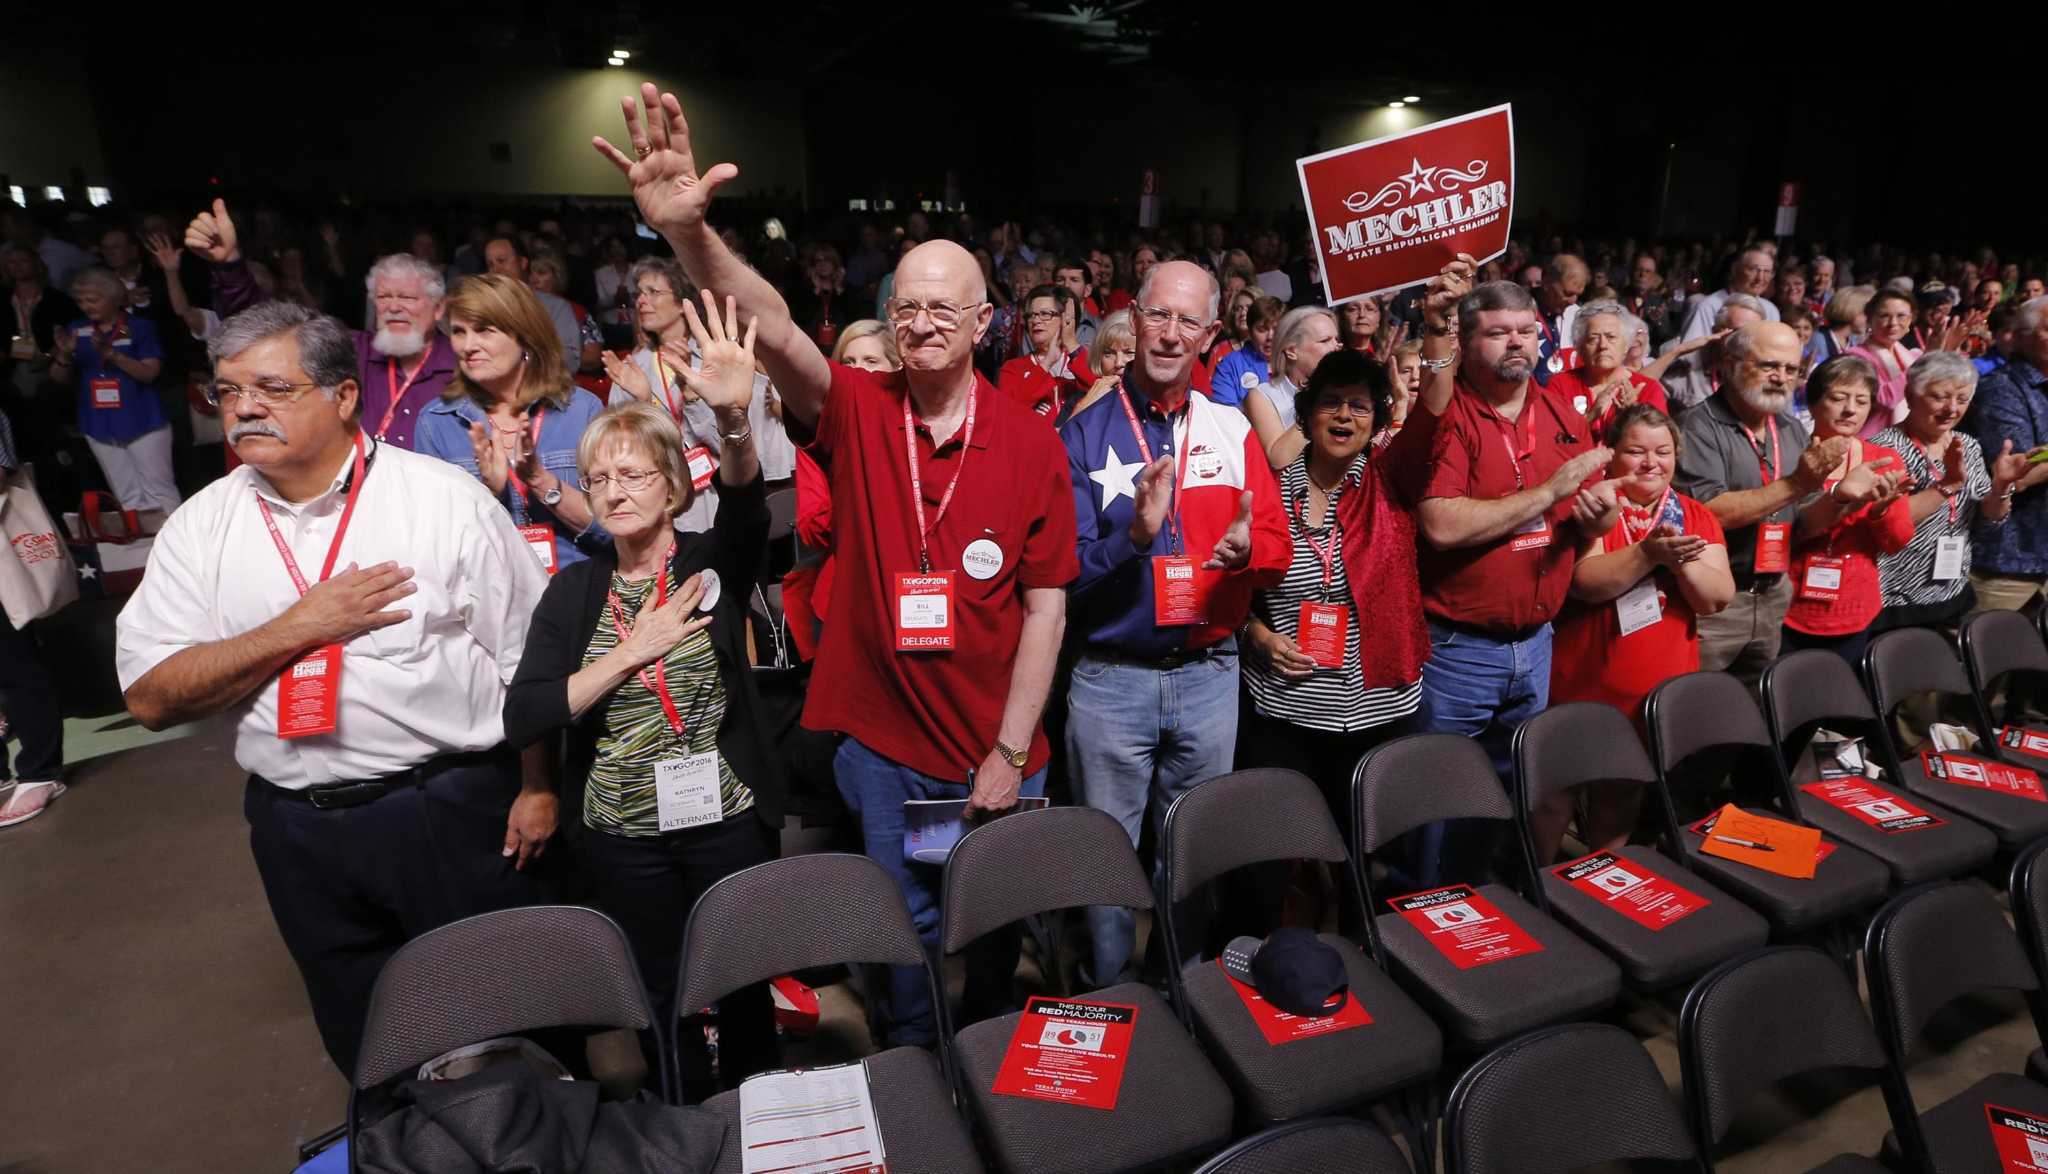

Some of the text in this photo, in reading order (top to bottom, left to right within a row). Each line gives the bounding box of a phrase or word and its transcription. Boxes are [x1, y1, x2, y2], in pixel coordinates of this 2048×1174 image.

[1324, 180, 1508, 254] MECHLER
[1347, 212, 1500, 261] STATE REPUBLICAN CHAIRMAN
[1514, 535, 1551, 548] DELEGATE
[966, 554, 1000, 567] MECHLER
[901, 636, 951, 647] DELEGATE
[674, 786, 705, 796] KATHRYN
[663, 812, 720, 828] ALTERNATE
[1058, 1002, 1075, 1010] THIS
[1084, 1004, 1107, 1013] YOUR
[1038, 1007, 1123, 1022] RED MAJORITY
[1089, 1032, 1101, 1041] 51
[1039, 1045, 1087, 1056] CONSERVATIVE
[1087, 1051, 1116, 1059] RESULTS
[2004, 1117, 2040, 1133] RED
